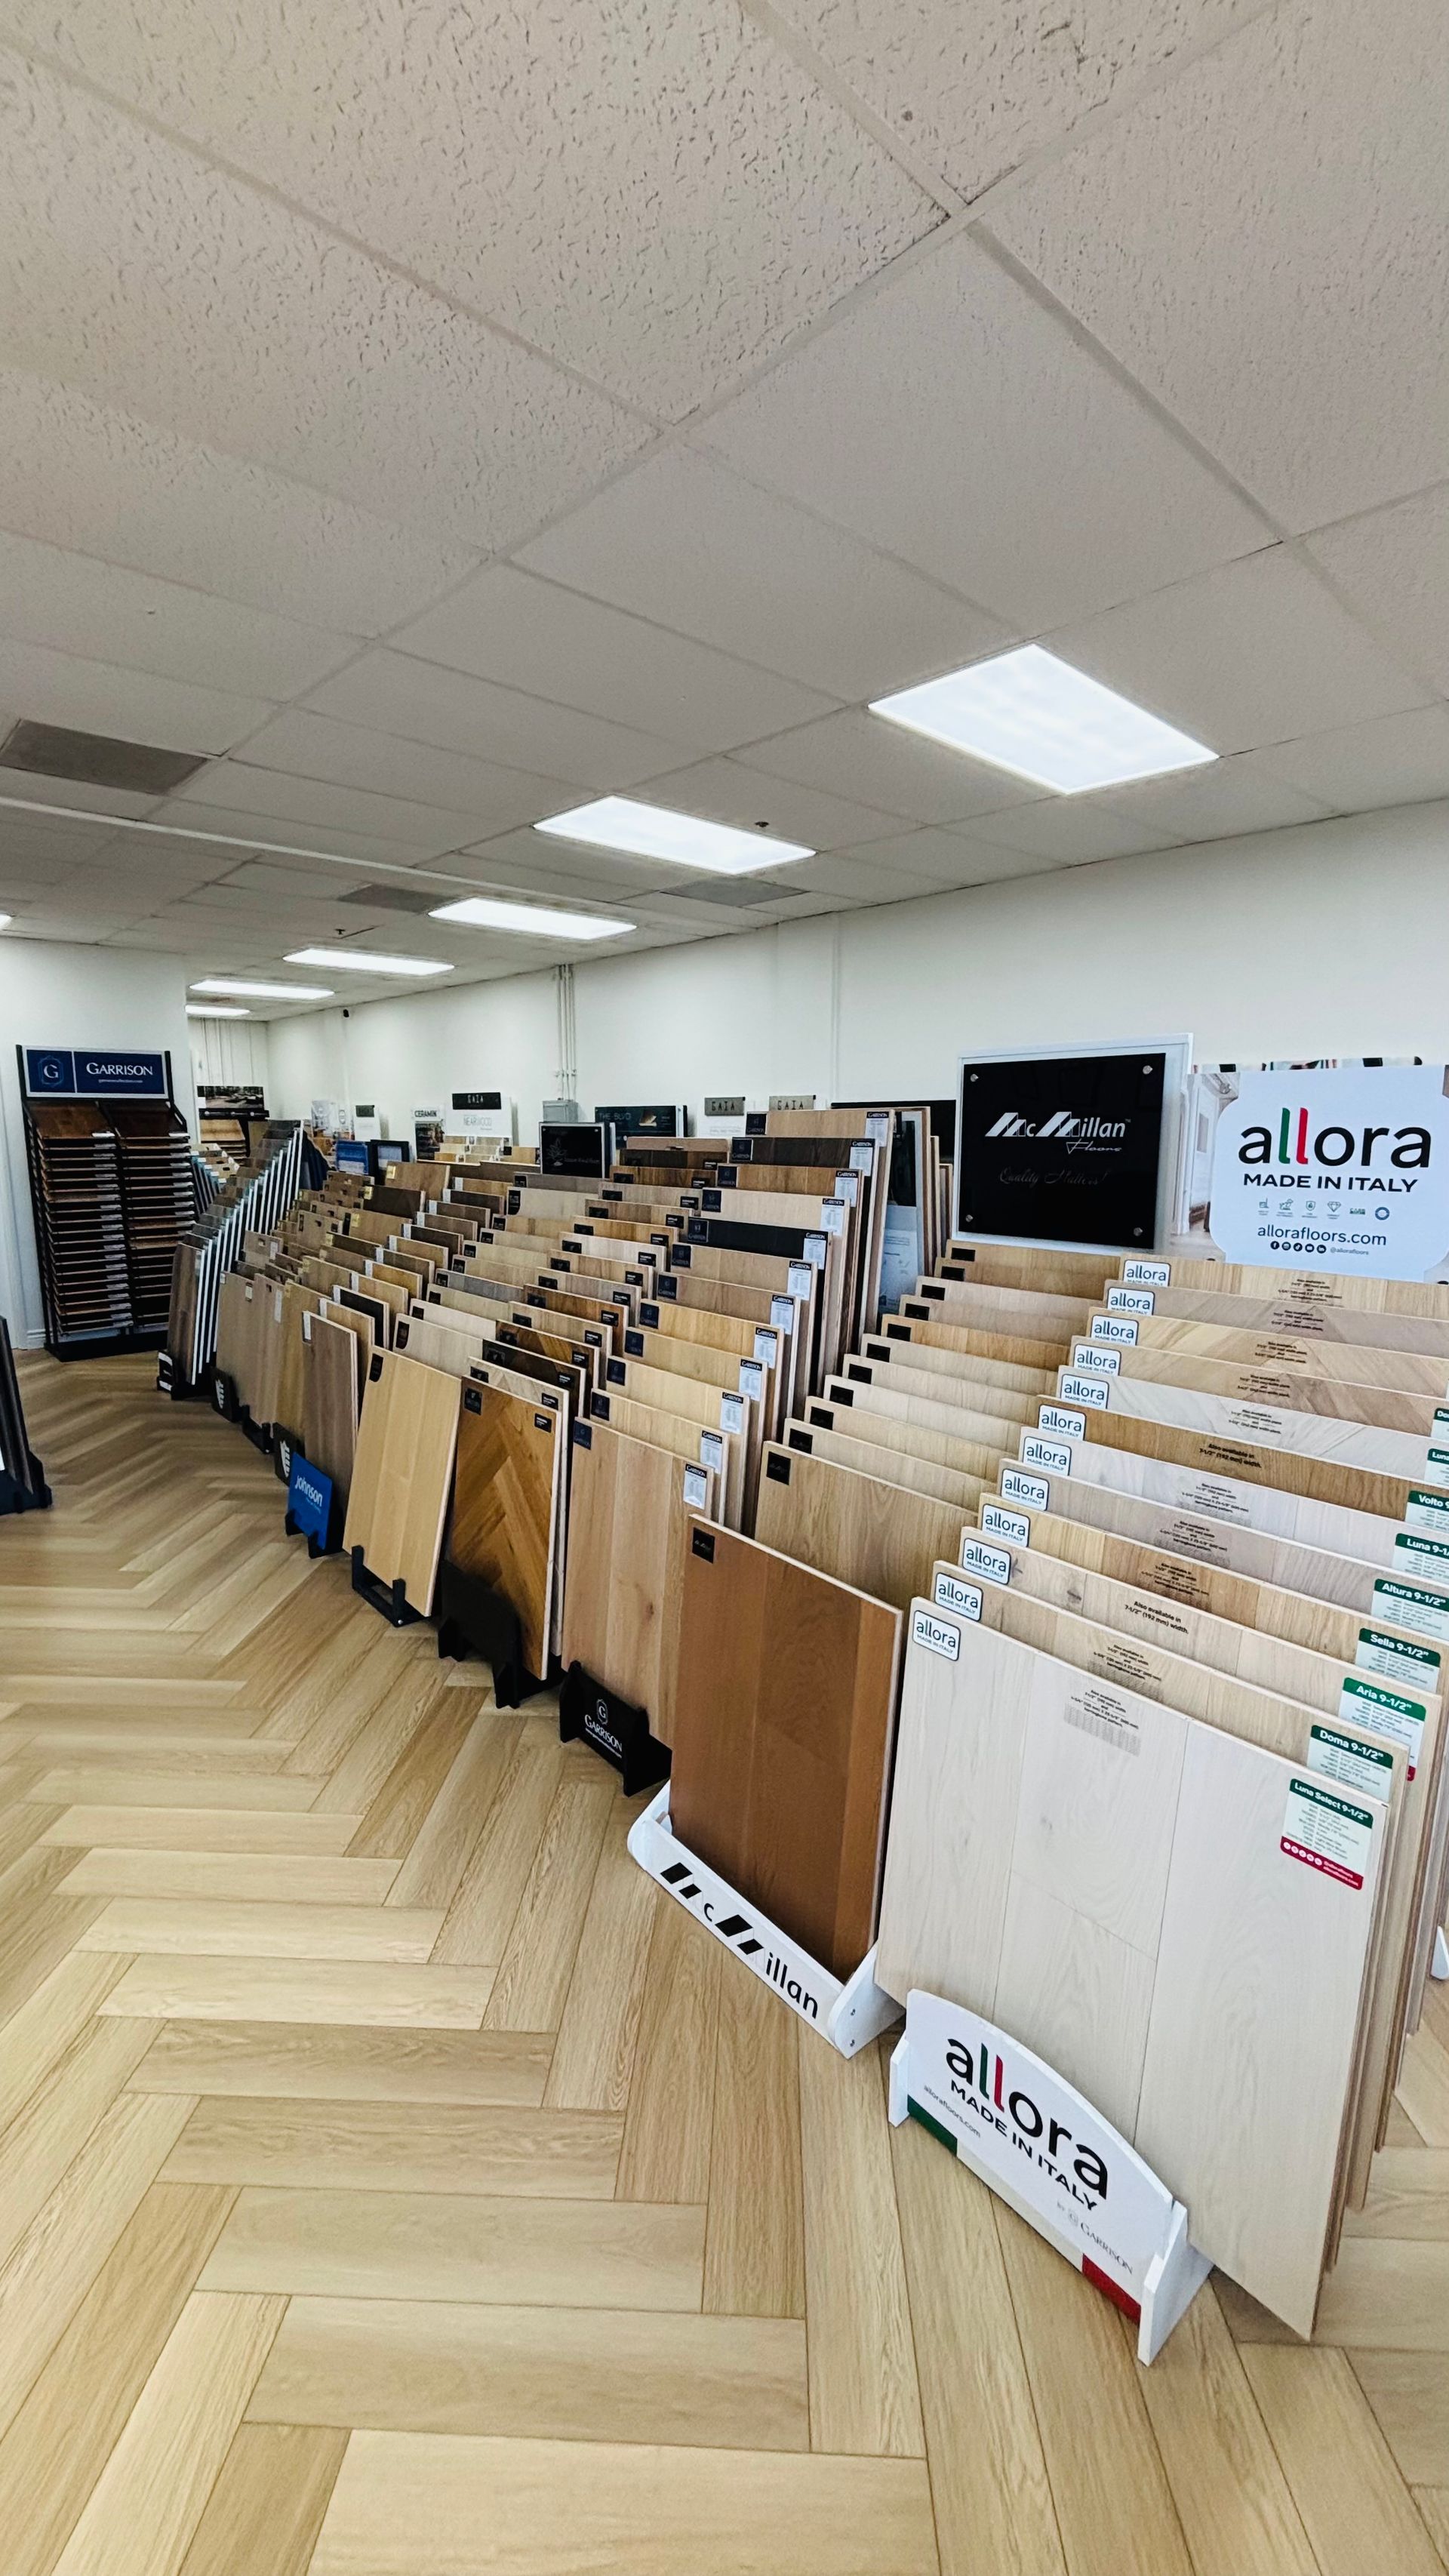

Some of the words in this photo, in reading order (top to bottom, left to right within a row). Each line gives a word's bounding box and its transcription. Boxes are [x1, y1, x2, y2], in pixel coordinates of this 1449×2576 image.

[86, 1062, 153, 1076] GARRISON
[711, 1101, 735, 1111] GAIA
[777, 1100, 804, 1110] GAIA
[1238, 1107, 1432, 1168] allora
[1243, 1173, 1312, 1189] MADE
[1317, 1176, 1341, 1190] IN
[1348, 1177, 1419, 1193] ITALY
[1257, 1223, 1387, 1246] allorafloors.com
[1127, 1265, 1166, 1281] allora
[1110, 1292, 1150, 1310] allora
[1094, 1320, 1134, 1338] allora
[1077, 1350, 1117, 1369] allora
[1064, 1380, 1105, 1401] allora
[1041, 1411, 1082, 1432] allora
[1026, 1443, 1067, 1466] allora
[1222, 1448, 1247, 1457] available
[294, 1475, 323, 1507] johnson
[1004, 1476, 1045, 1500] allora
[1419, 1494, 1444, 1507] Volto
[986, 1512, 1026, 1537] allora
[1407, 1538, 1430, 1551] Luna
[966, 1546, 1007, 1572] allora
[938, 1581, 978, 1609] allora
[1382, 1583, 1412, 1598] Altura
[1134, 1601, 1147, 1610] Also
[1148, 1606, 1175, 1620] available
[916, 1619, 956, 1648] allora
[1142, 1612, 1155, 1621] (192
[1155, 1617, 1170, 1627] mm)
[1170, 1623, 1189, 1635] width.
[1370, 1634, 1395, 1649] Sella
[1356, 1685, 1377, 1700] Aria
[584, 1714, 623, 1752] GARRISON
[1319, 1730, 1349, 1749] Doma
[1294, 1782, 1314, 1796] Luna
[1315, 1791, 1341, 1810] Select
[924, 2084, 981, 2138] allorafloors.com
[946, 2038, 1108, 2200] allora
[950, 2079, 1008, 2137] MADE
[1012, 2132, 1033, 2159] IN
[1038, 2154, 1098, 2211] ITALY
[1080, 2222, 1134, 2275] GARRISON
